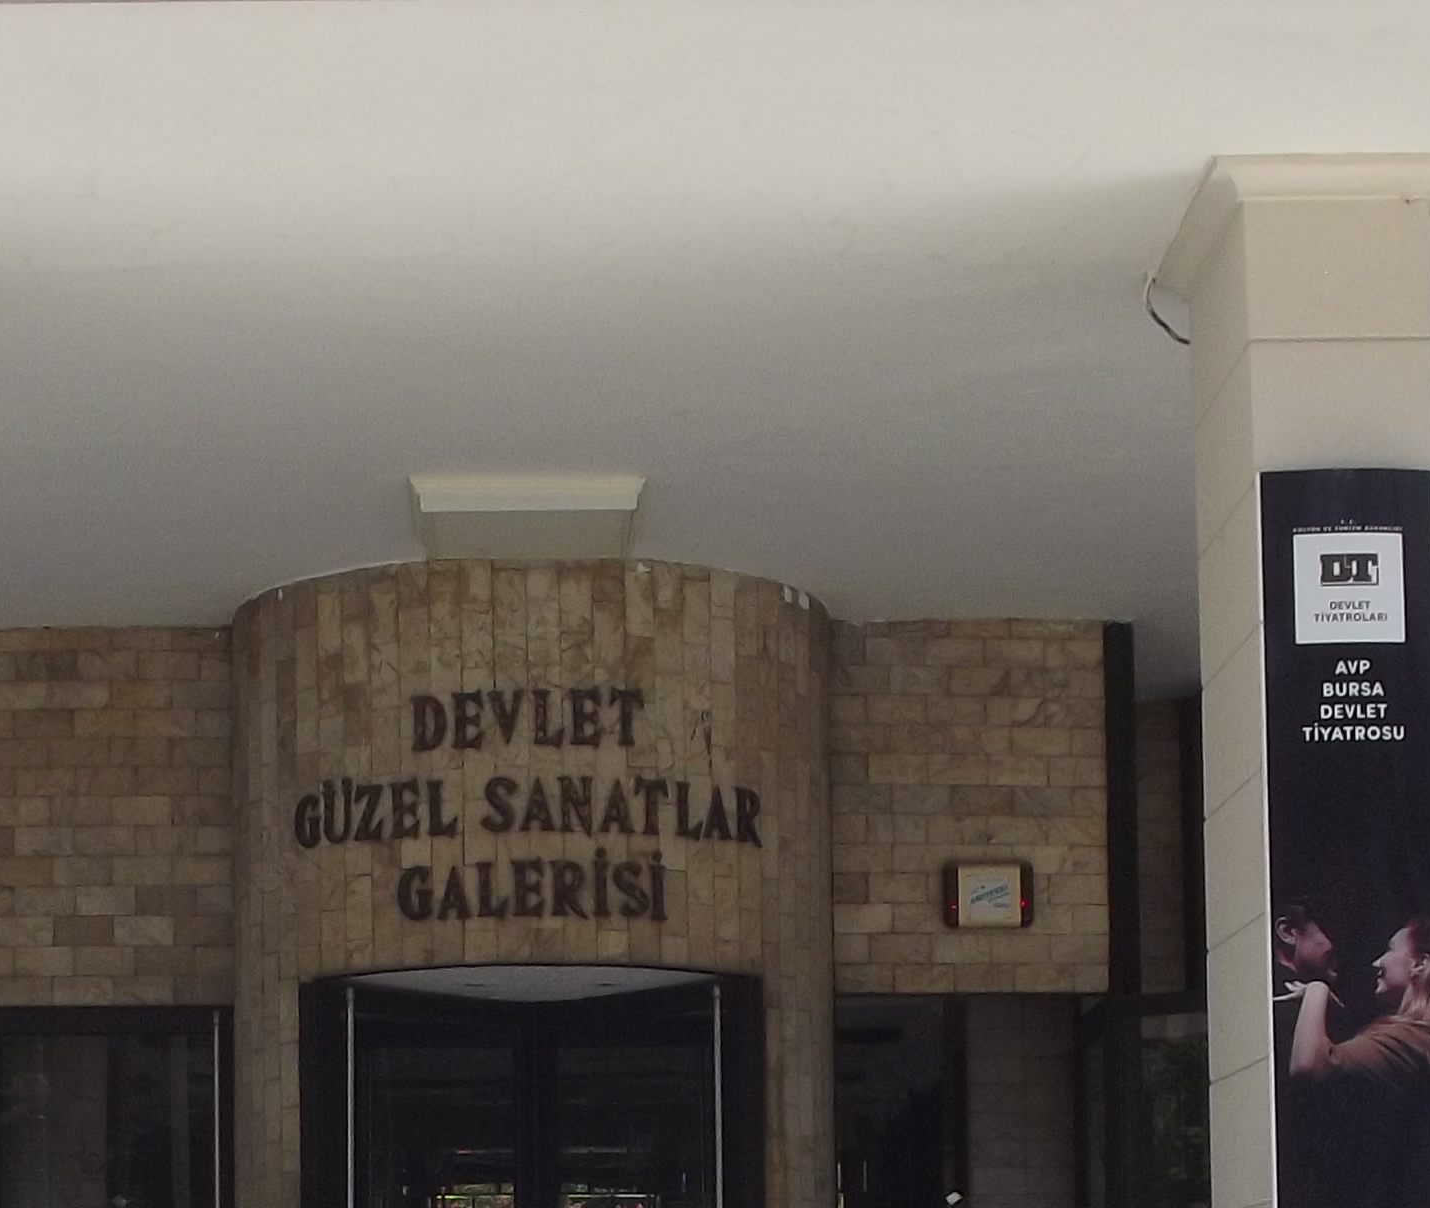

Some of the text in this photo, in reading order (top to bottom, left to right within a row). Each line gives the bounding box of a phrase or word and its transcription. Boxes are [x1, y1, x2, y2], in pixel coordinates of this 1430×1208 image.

[1329, 601, 1370, 610] DEVLET
[1314, 612, 1388, 622] TİYATROLARI
[1335, 659, 1371, 675] AVP
[1322, 682, 1385, 698] BURSA
[1320, 703, 1388, 719] DEVLET
[411, 688, 644, 751] DEVLET
[1302, 722, 1405, 742] TİYATROSU
[294, 775, 763, 849] GÜZEL SANATLAR
[397, 849, 669, 922] GALERİSİ
